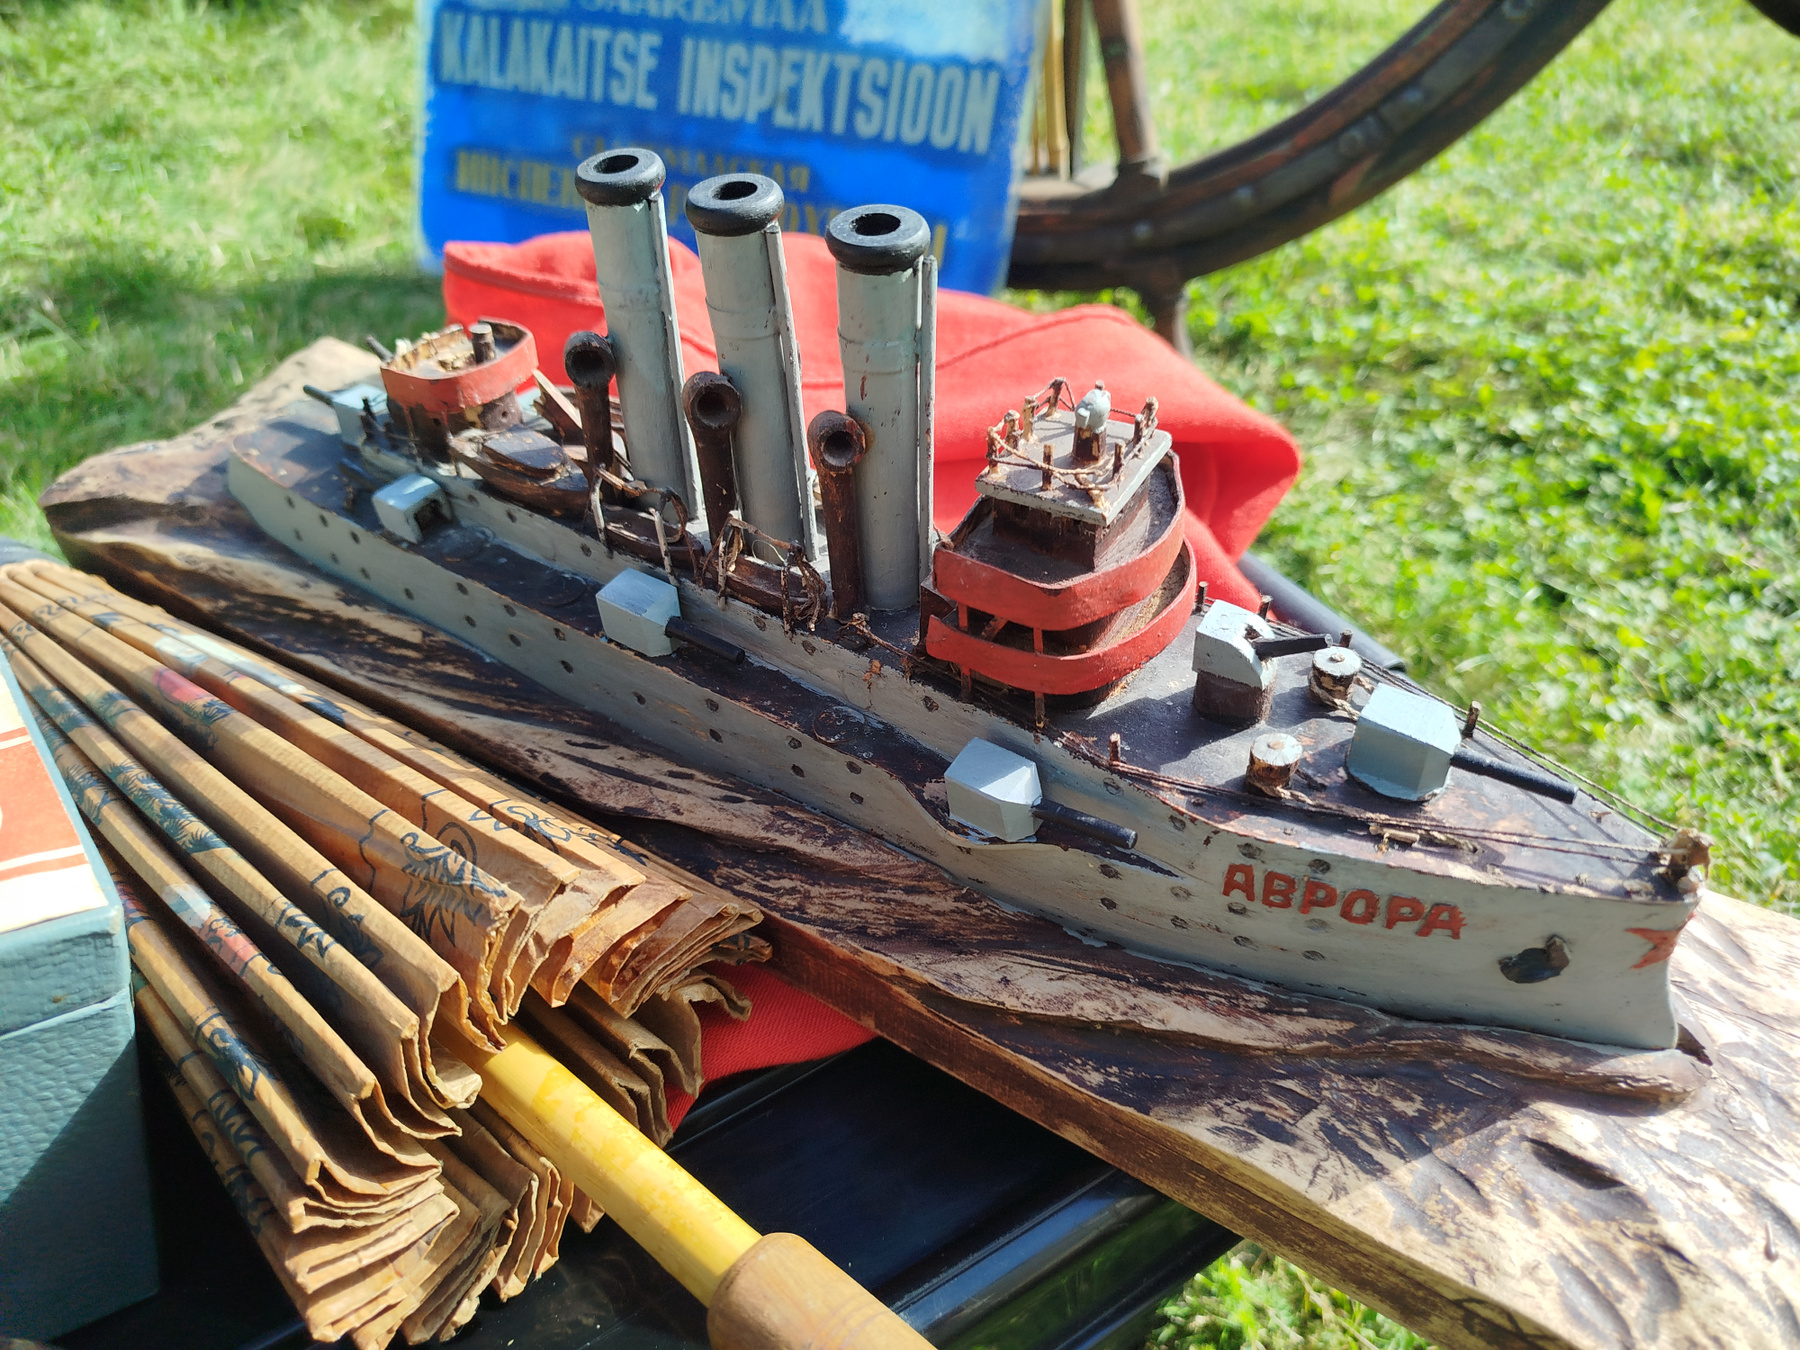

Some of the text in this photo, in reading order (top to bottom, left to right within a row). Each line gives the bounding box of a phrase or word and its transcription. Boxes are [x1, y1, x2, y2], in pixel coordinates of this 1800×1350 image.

[440, 11, 1000, 155] KALAKAITSE INSPEKTSIOON
[1222, 862, 1467, 940] АВРОРА
